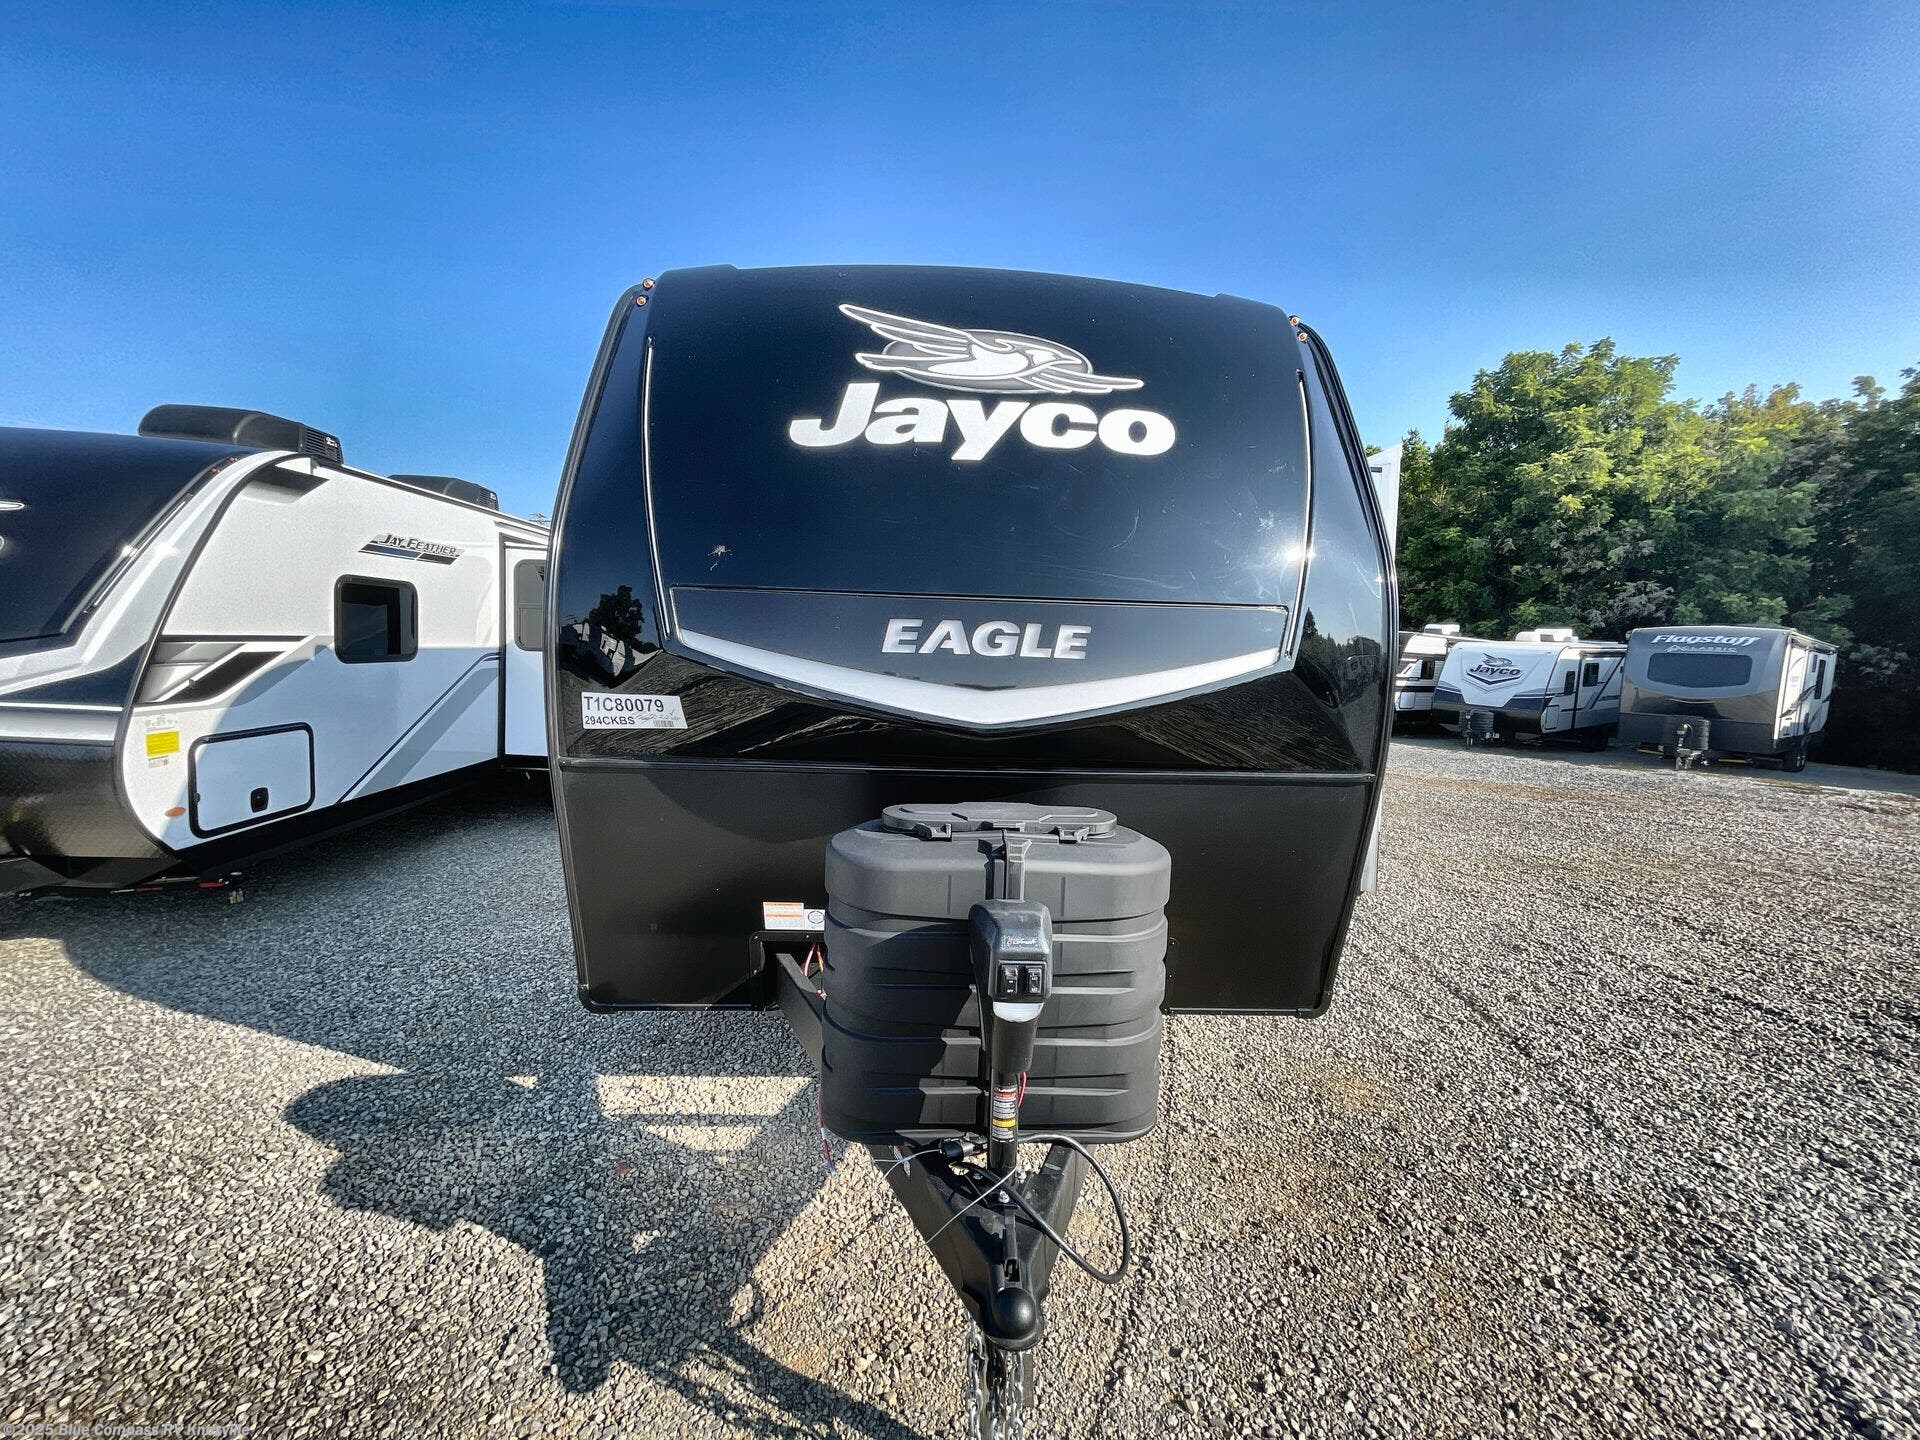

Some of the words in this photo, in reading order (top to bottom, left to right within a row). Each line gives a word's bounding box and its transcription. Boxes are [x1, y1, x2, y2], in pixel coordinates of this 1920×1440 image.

[789, 382, 1176, 461] Jayco
[381, 534, 405, 547] JAY
[407, 538, 457, 556] FEATHER
[881, 618, 1092, 660] EAGLE
[1650, 634, 1760, 647] Flagstaff
[1469, 664, 1521, 675] Jayco
[584, 696, 664, 712] T1C80079
[585, 716, 635, 725] 294CKBS
